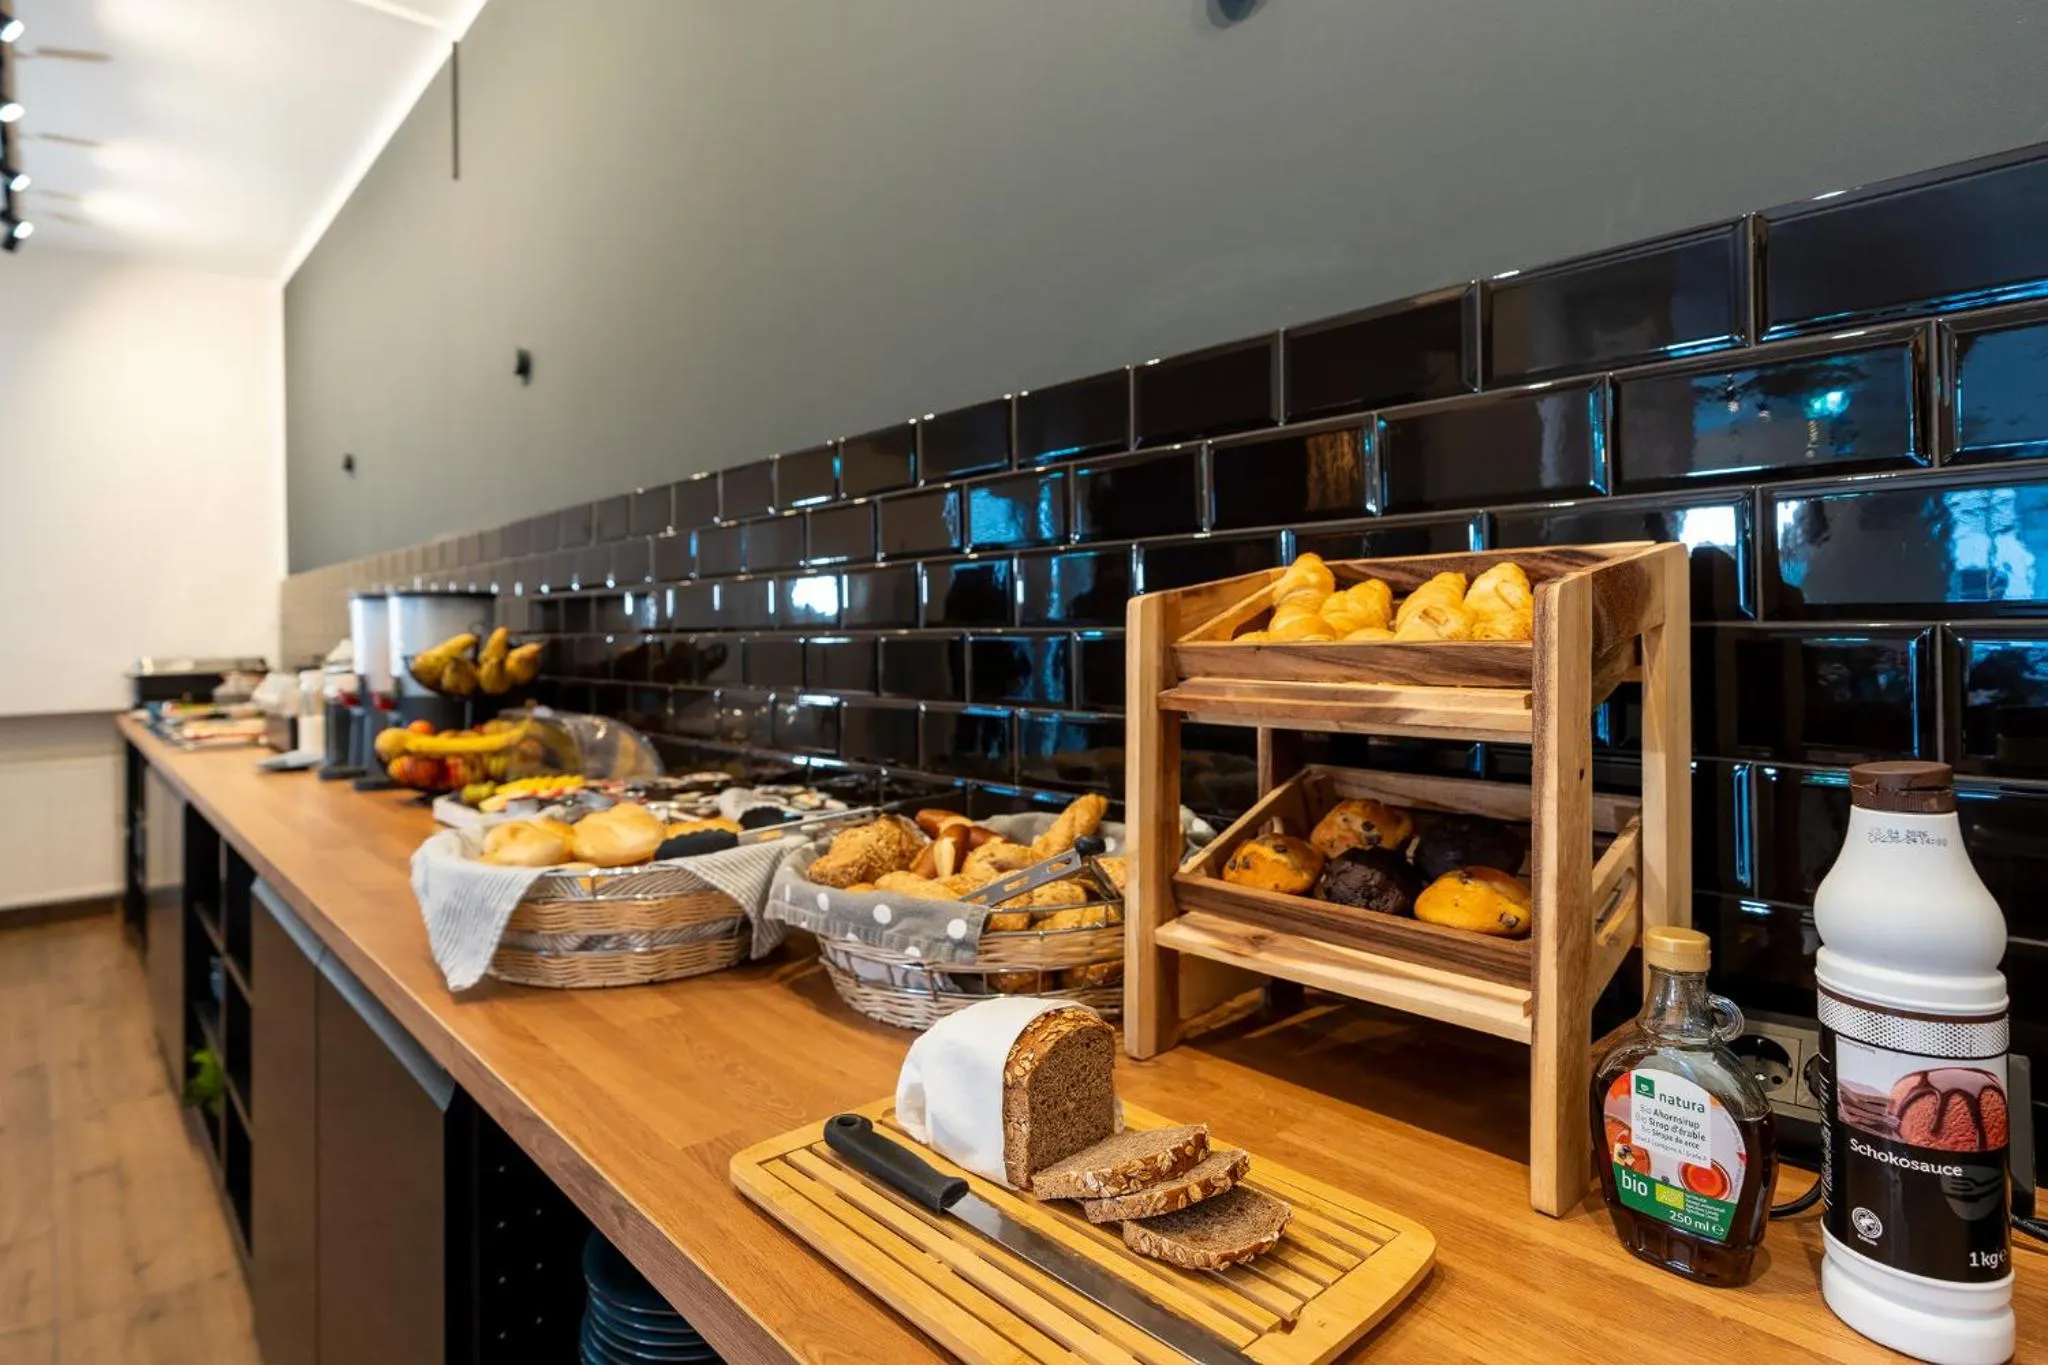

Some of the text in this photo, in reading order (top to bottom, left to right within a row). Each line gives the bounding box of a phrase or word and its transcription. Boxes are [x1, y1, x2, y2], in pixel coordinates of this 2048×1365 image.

[1659, 1092, 1705, 1113] natura
[1653, 1108, 1700, 1129] Ahornsirup
[1849, 1137, 1963, 1177] Schokosauce
[1621, 1169, 1648, 1196] bio
[1669, 1210, 1692, 1225] 250
[1695, 1221, 1709, 1232] ml
